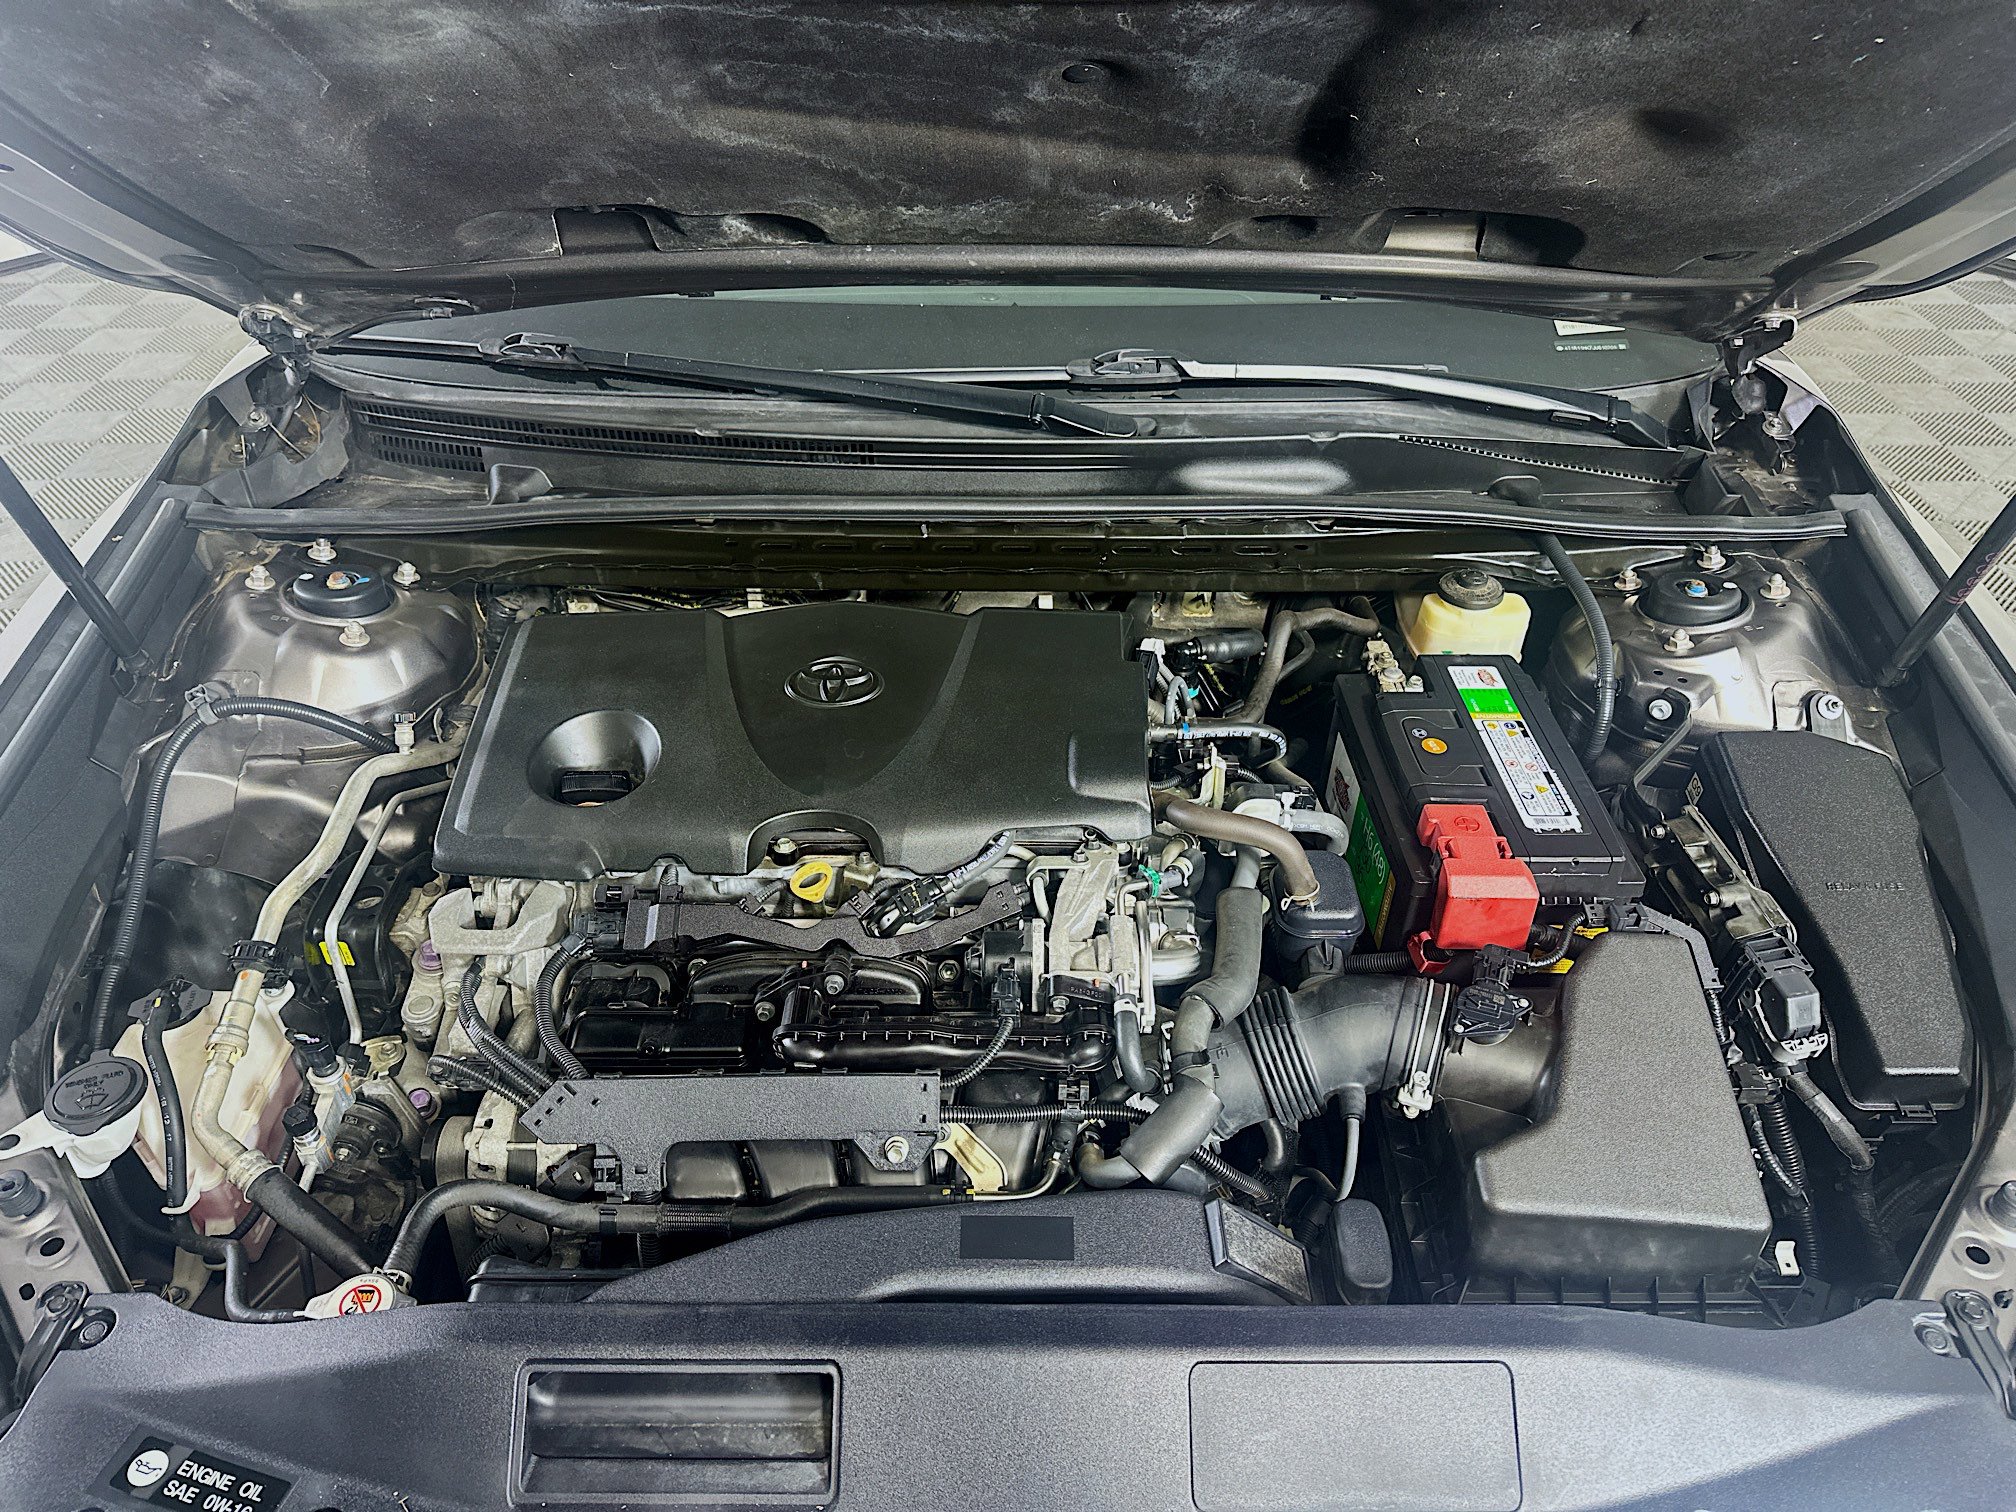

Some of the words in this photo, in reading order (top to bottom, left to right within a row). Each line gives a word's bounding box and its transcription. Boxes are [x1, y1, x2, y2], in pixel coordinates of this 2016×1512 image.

[163, 1479, 200, 1504] SAE
[176, 1459, 237, 1491] ENGINE
[238, 1481, 264, 1502] OIL
